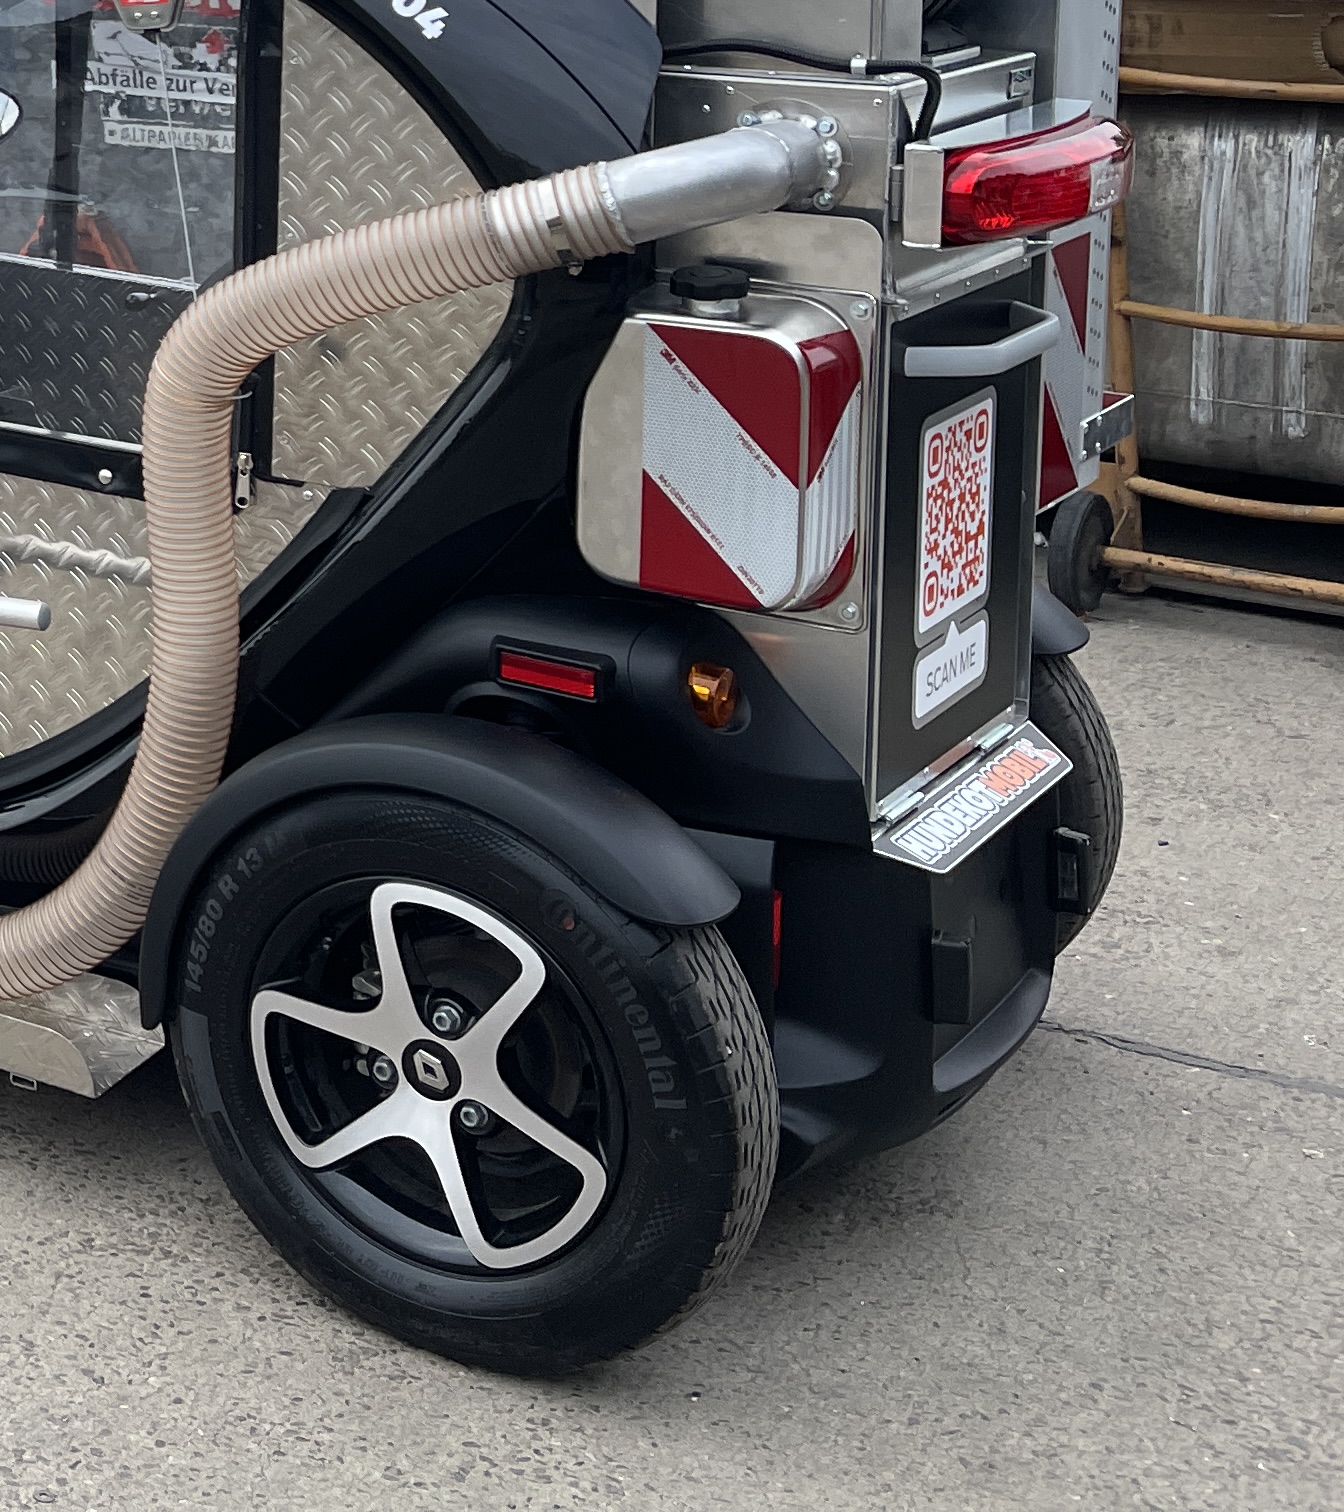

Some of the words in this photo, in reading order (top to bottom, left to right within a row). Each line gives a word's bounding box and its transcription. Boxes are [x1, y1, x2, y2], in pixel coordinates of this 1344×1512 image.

[84, 65, 158, 90] Abfälle
[166, 77, 197, 94] zur
[925, 657, 958, 698] SCAN
[961, 642, 977, 672] ME
[896, 747, 1051, 863] HUNDEKOTMOBIL
[237, 846, 265, 880] 13
